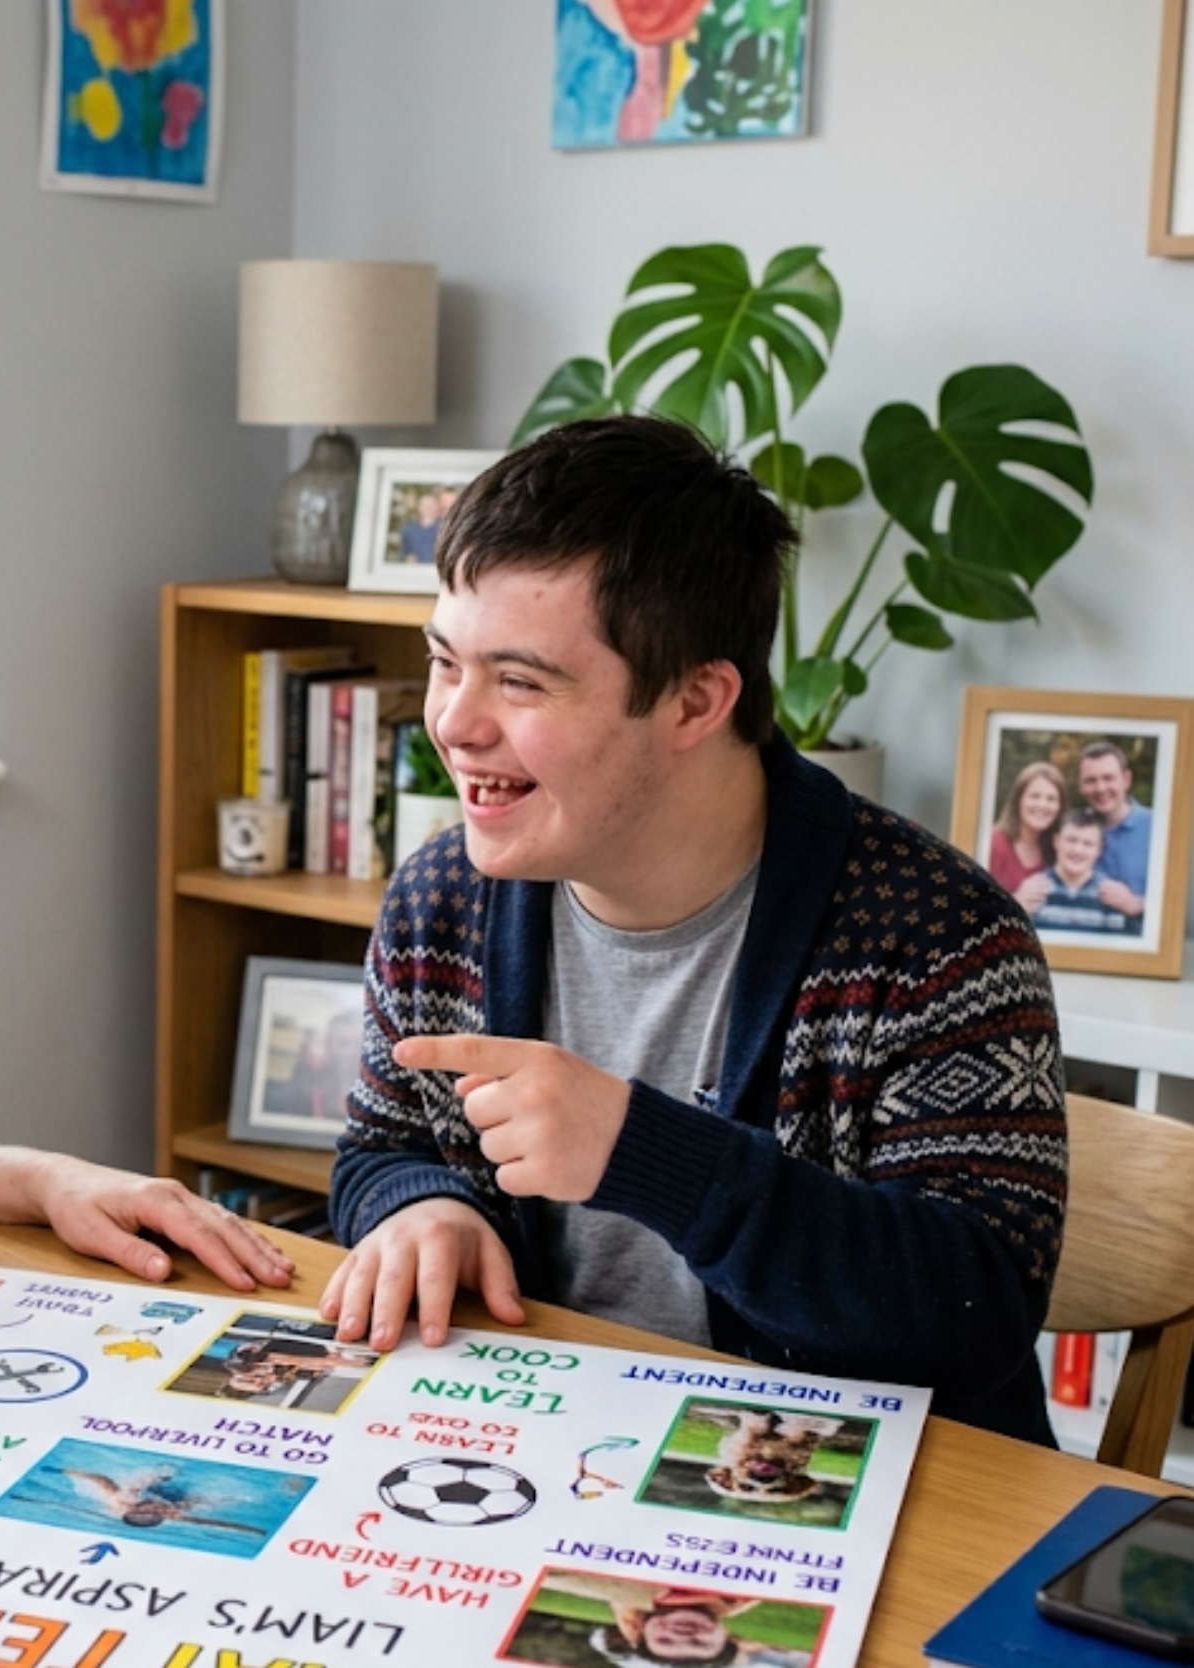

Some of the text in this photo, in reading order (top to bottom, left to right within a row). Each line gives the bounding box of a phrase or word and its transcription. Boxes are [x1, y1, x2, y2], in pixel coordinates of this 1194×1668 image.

[459, 1342, 580, 1370] COOK
[496, 1369, 538, 1386] TO
[620, 1365, 903, 1412] BE INDEPENDENT
[80, 1416, 329, 1464] GO TO LIVERPOOL
[214, 1418, 334, 1447] MATCH
[289, 1539, 523, 1588] GIRLLFRIEND
[544, 1538, 841, 1593] BE INDEPENDENT
[342, 1571, 489, 1609] HAVE A
[207, 1598, 406, 1655] LIAM'S
